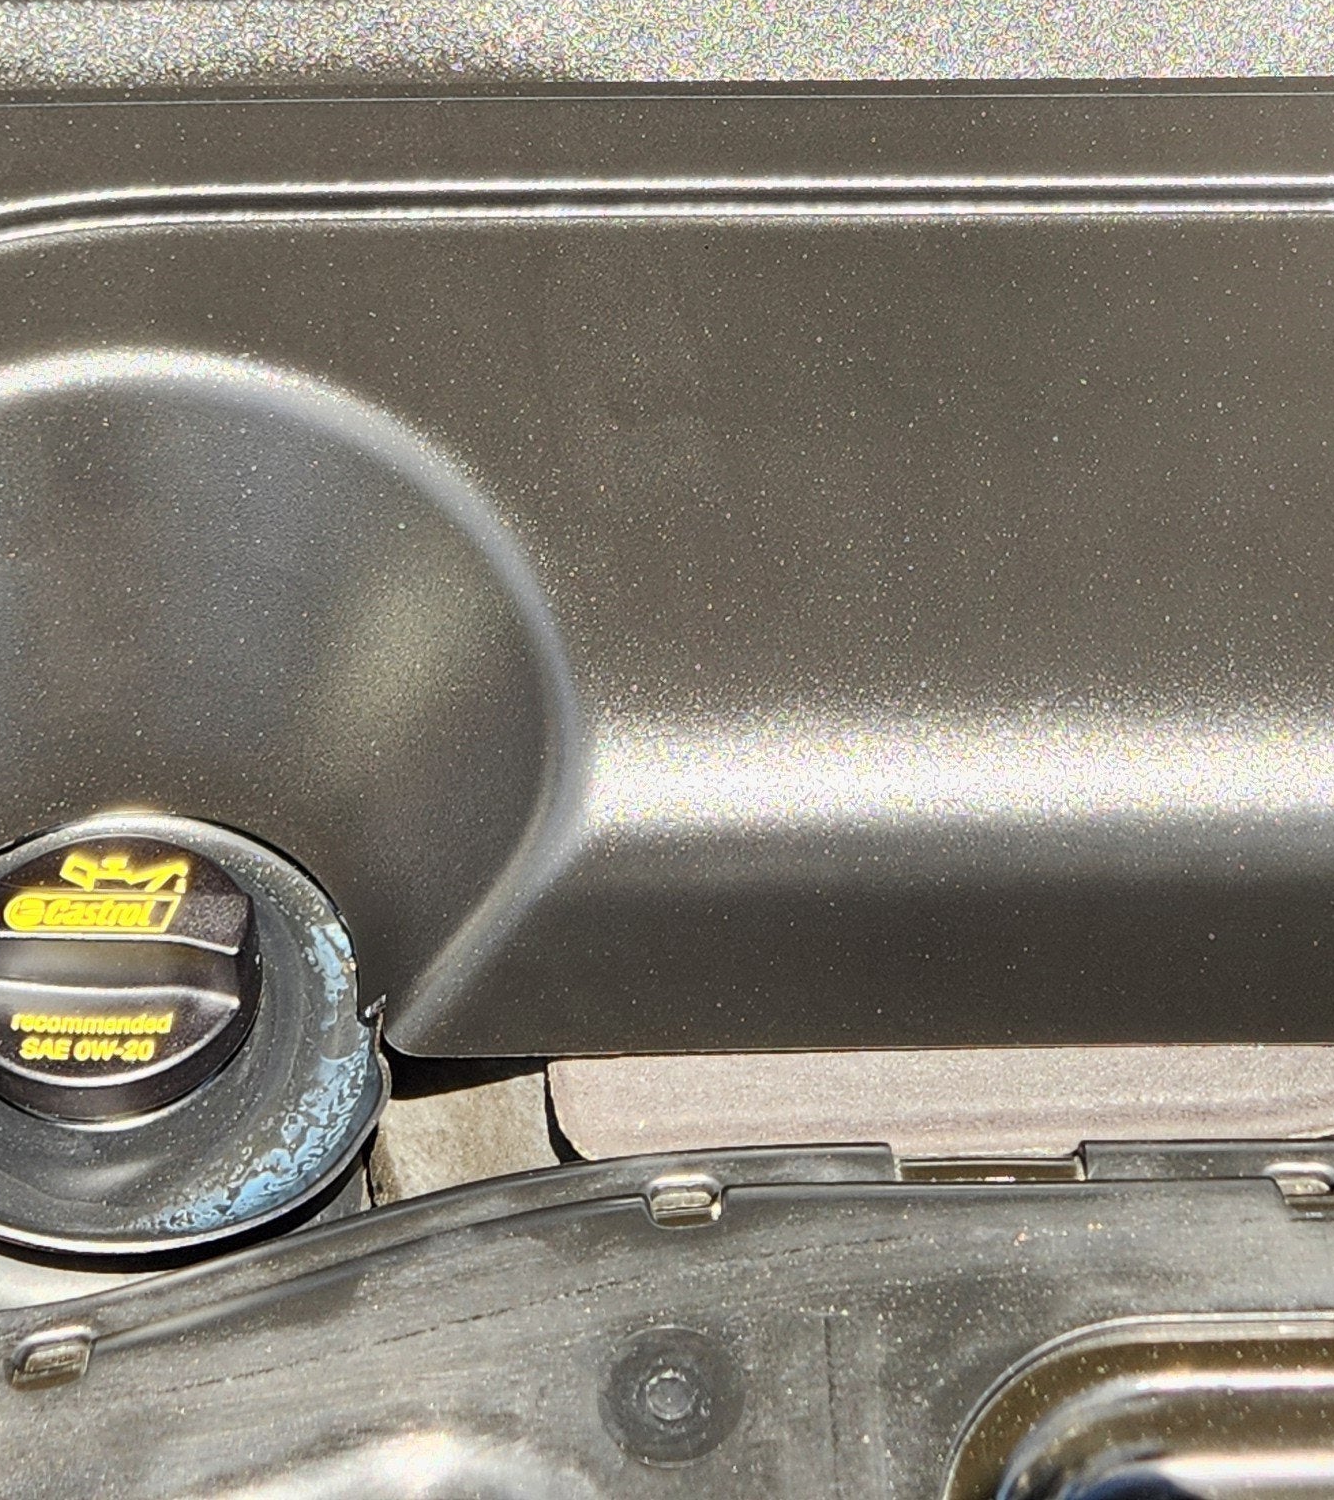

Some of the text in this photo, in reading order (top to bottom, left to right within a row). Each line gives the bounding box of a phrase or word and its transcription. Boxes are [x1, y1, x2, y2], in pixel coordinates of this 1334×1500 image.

[41, 900, 156, 926] Castrol
[11, 1012, 173, 1034] recommended
[19, 1037, 155, 1060] SAE 0W-20
